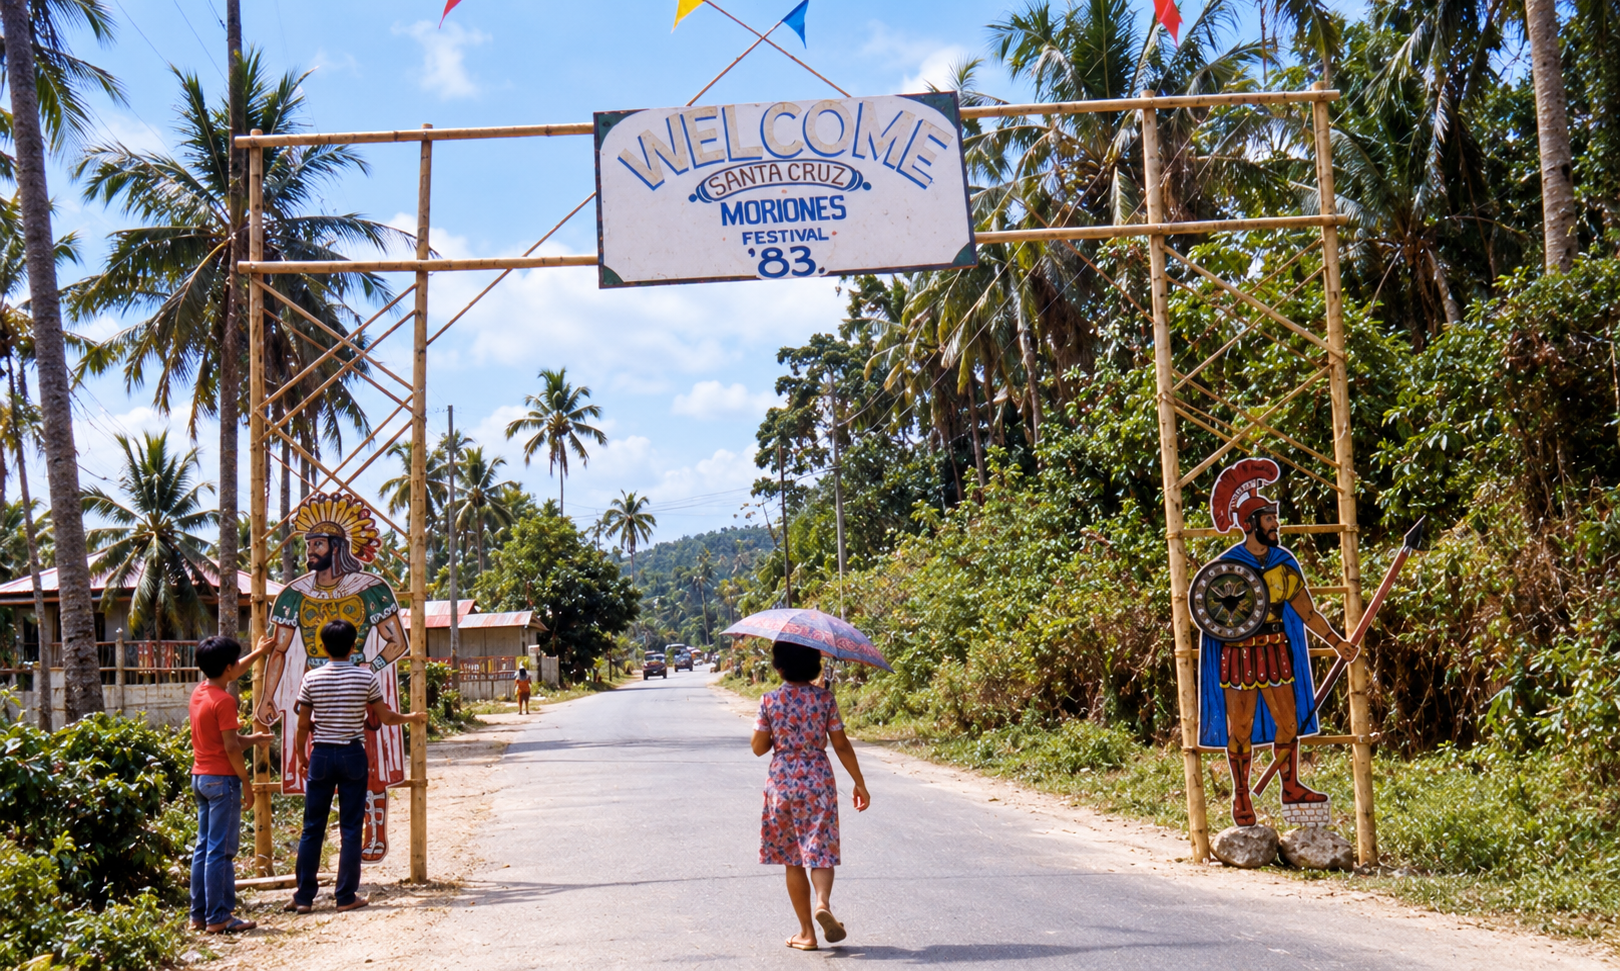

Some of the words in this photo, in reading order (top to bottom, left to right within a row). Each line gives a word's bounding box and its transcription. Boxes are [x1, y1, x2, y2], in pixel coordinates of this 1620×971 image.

[617, 100, 954, 191] WELCOME
[708, 163, 783, 196] SANTA
[787, 162, 847, 187] CRUZ
[721, 195, 847, 226] MORIONES
[742, 228, 829, 245] FESTIVAL
